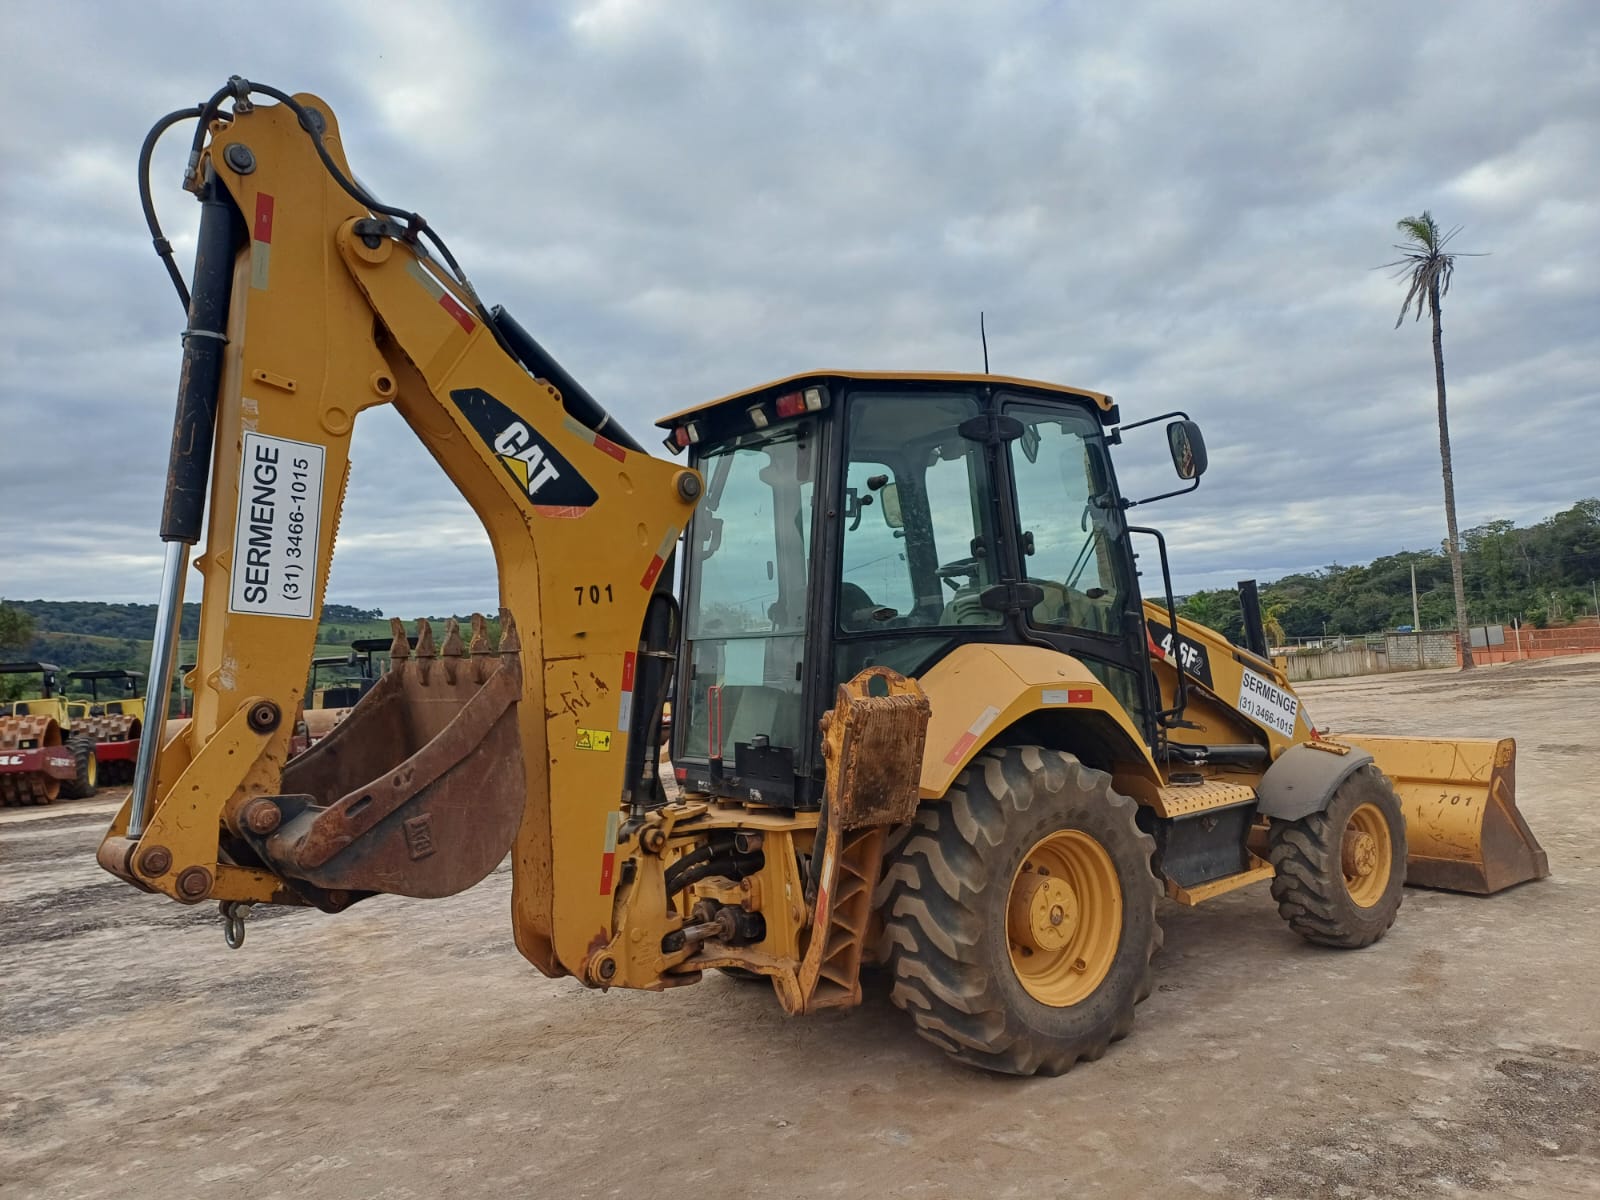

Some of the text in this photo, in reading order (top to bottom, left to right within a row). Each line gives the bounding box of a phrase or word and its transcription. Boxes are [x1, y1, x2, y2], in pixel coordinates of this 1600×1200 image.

[494, 421, 560, 495] CAT
[244, 445, 279, 604] SERMENGE
[282, 458, 308, 600] (31) 3466-1015
[574, 583, 613, 606] 701
[1161, 632, 1204, 675] 46F2
[1239, 695, 1293, 735] (31) 3466-1015
[1243, 673, 1297, 716] SERMENGE
[1438, 794, 1472, 807] 701
